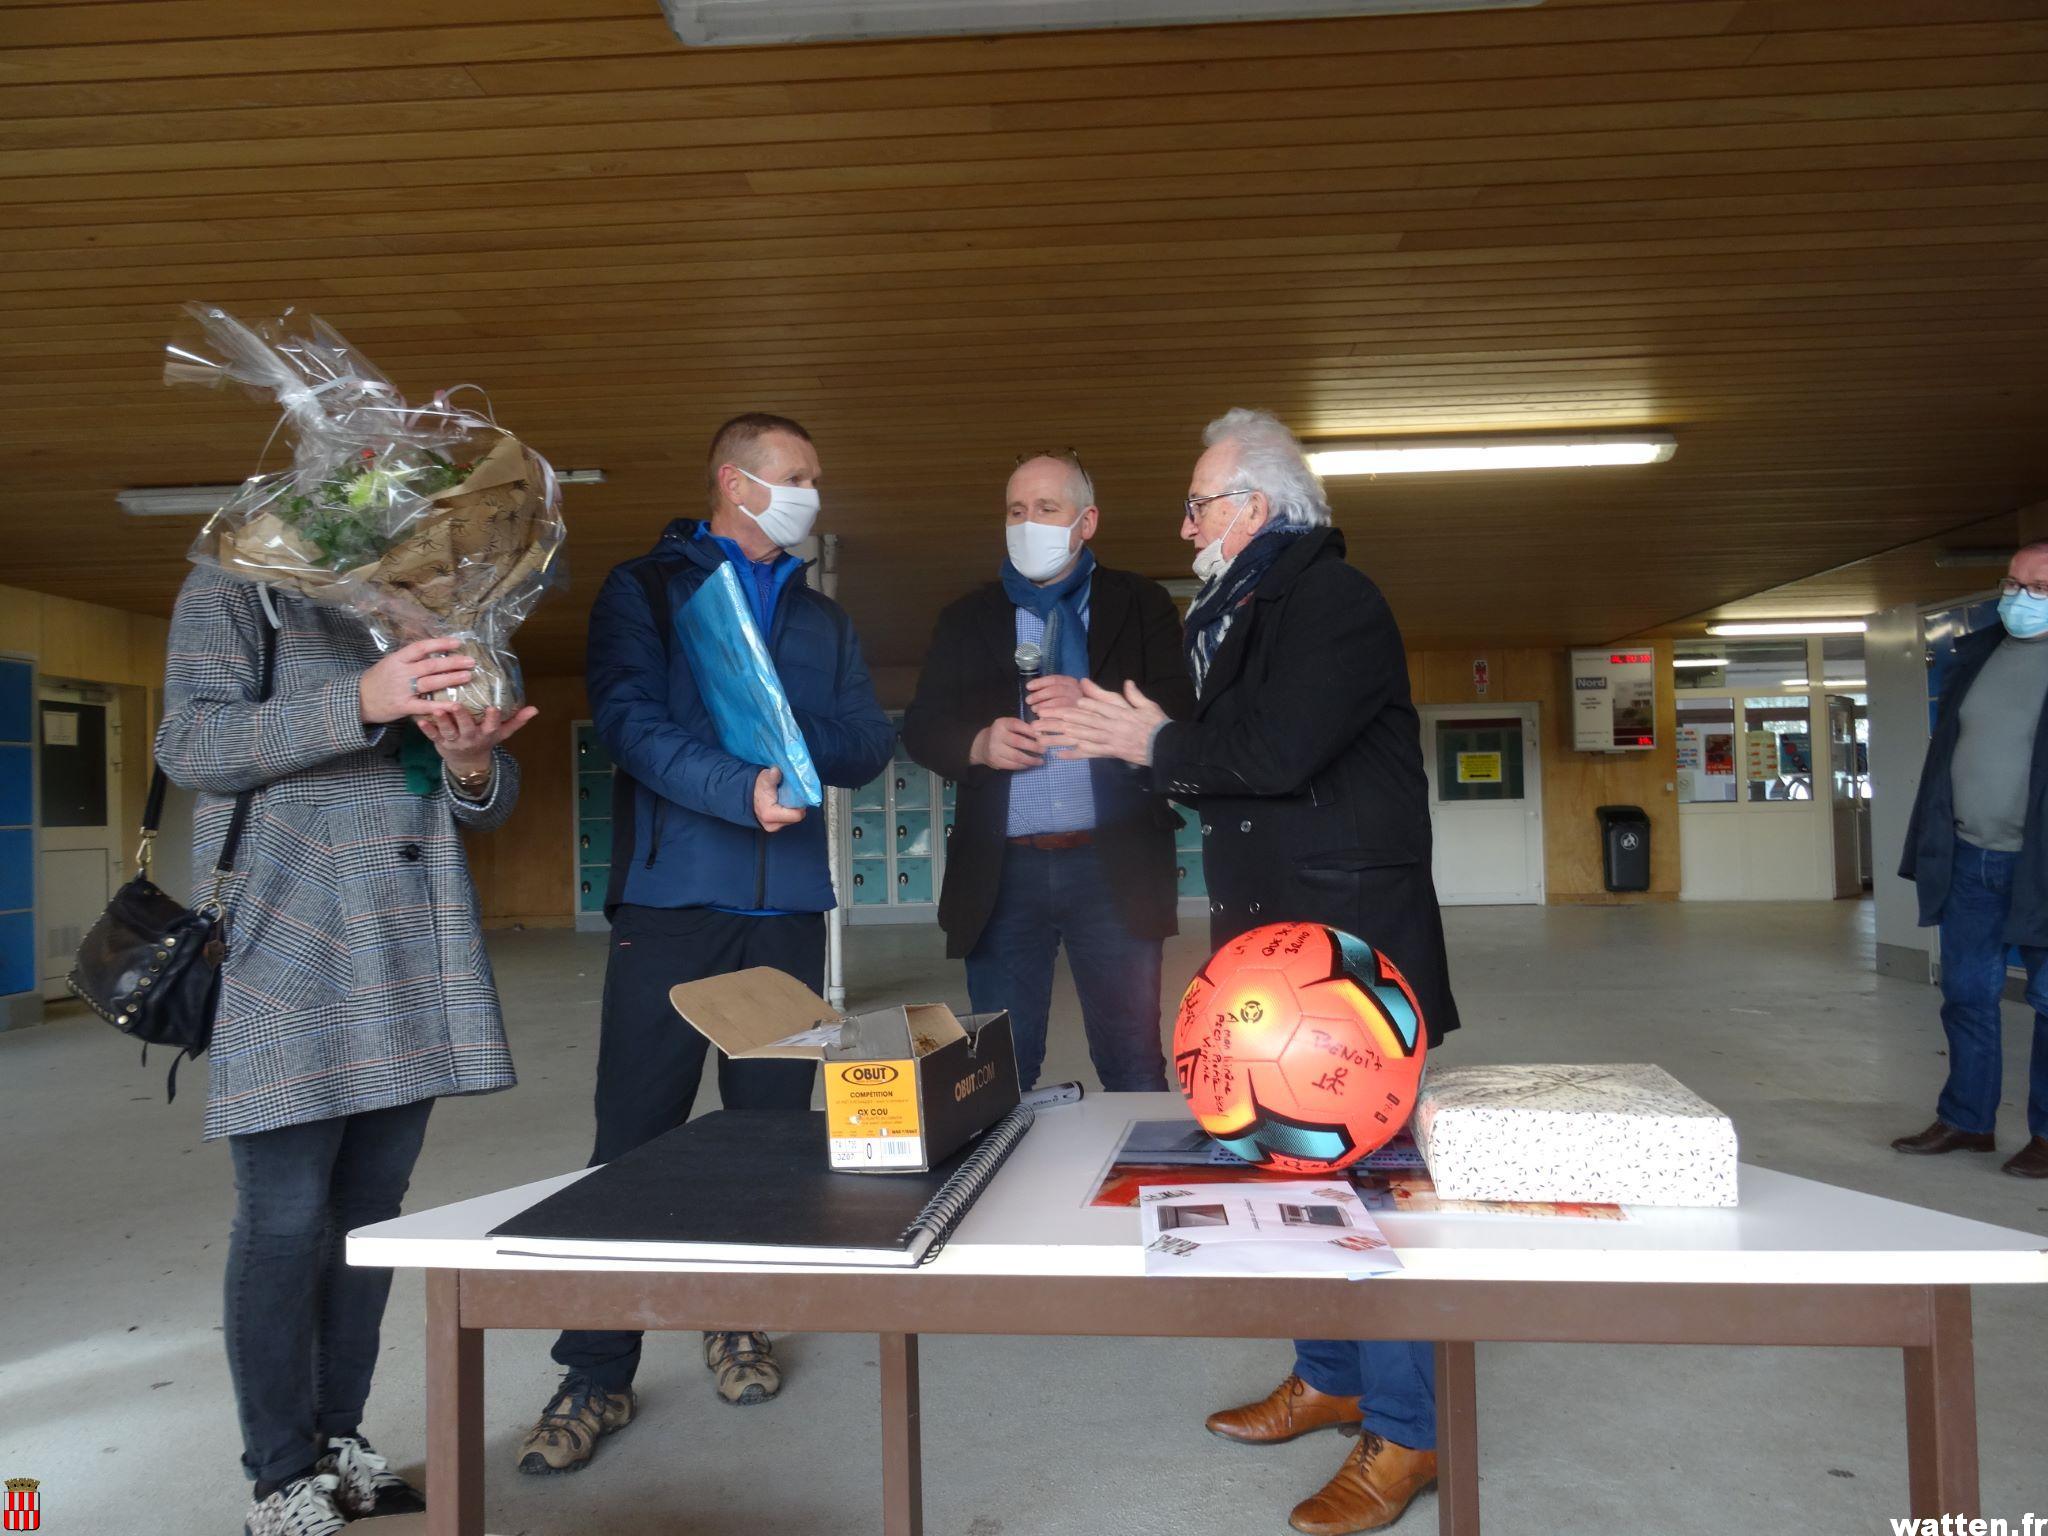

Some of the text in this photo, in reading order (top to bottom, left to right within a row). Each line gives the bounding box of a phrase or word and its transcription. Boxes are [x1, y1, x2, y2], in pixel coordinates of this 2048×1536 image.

[1577, 678, 1605, 688] Nord
[853, 1067, 888, 1081] OBUT
[954, 1061, 996, 1103] OBUT.COM
[870, 1108, 888, 1116] COU
